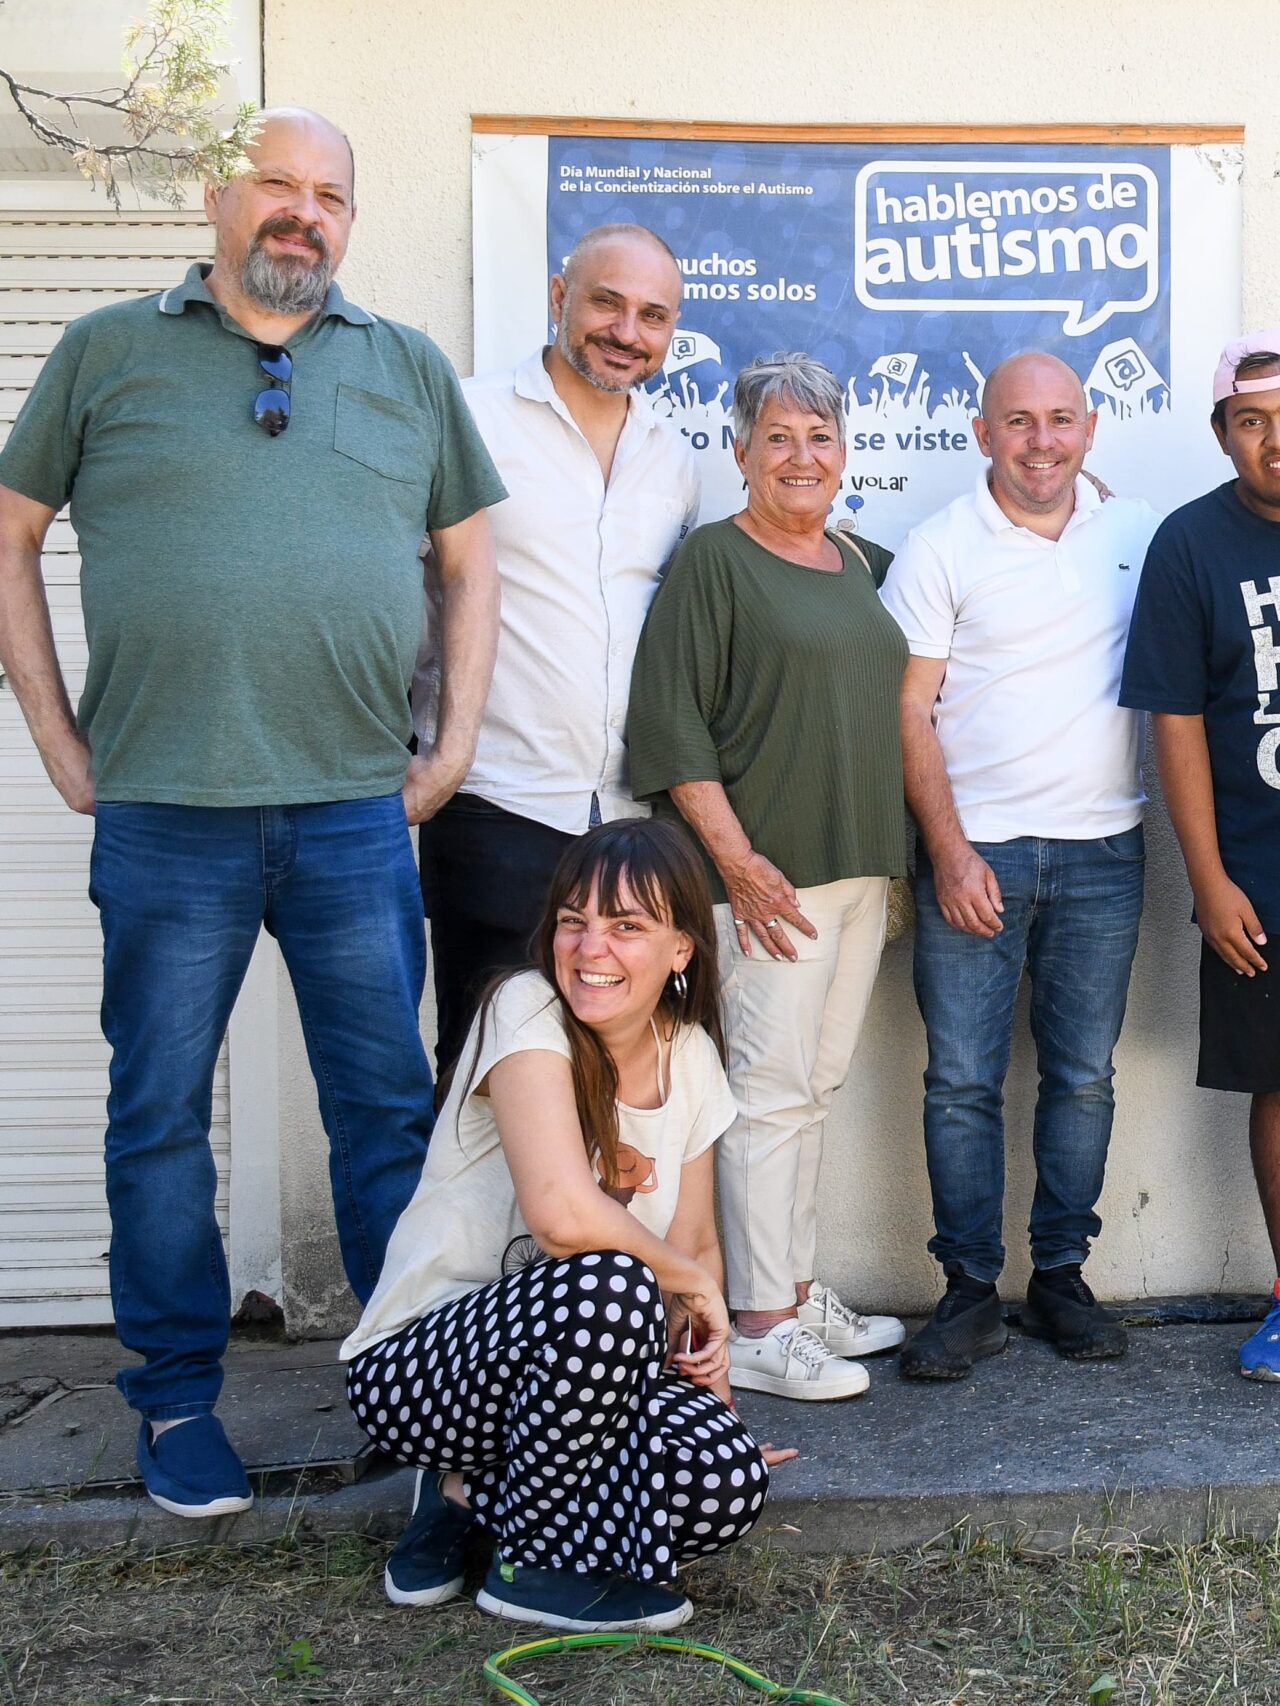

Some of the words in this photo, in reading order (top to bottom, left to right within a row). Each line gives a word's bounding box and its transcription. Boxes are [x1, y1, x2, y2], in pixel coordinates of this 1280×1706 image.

[560, 165, 583, 178] Día
[585, 166, 640, 179] Mundial
[643, 169, 651, 181] y
[654, 167, 712, 179] Nacional
[560, 180, 577, 192] de
[580, 181, 592, 193] la
[595, 180, 700, 194] Concientización
[702, 182, 740, 194] sobre
[743, 182, 755, 195] el
[758, 183, 813, 195] Autismo
[875, 181, 1078, 225] hablemos
[1086, 174, 1137, 210] de
[865, 217, 1149, 286] autismo
[747, 278, 817, 301] solos
[1113, 358, 1138, 380] a
[854, 431, 886, 451] se
[895, 425, 968, 451] viste
